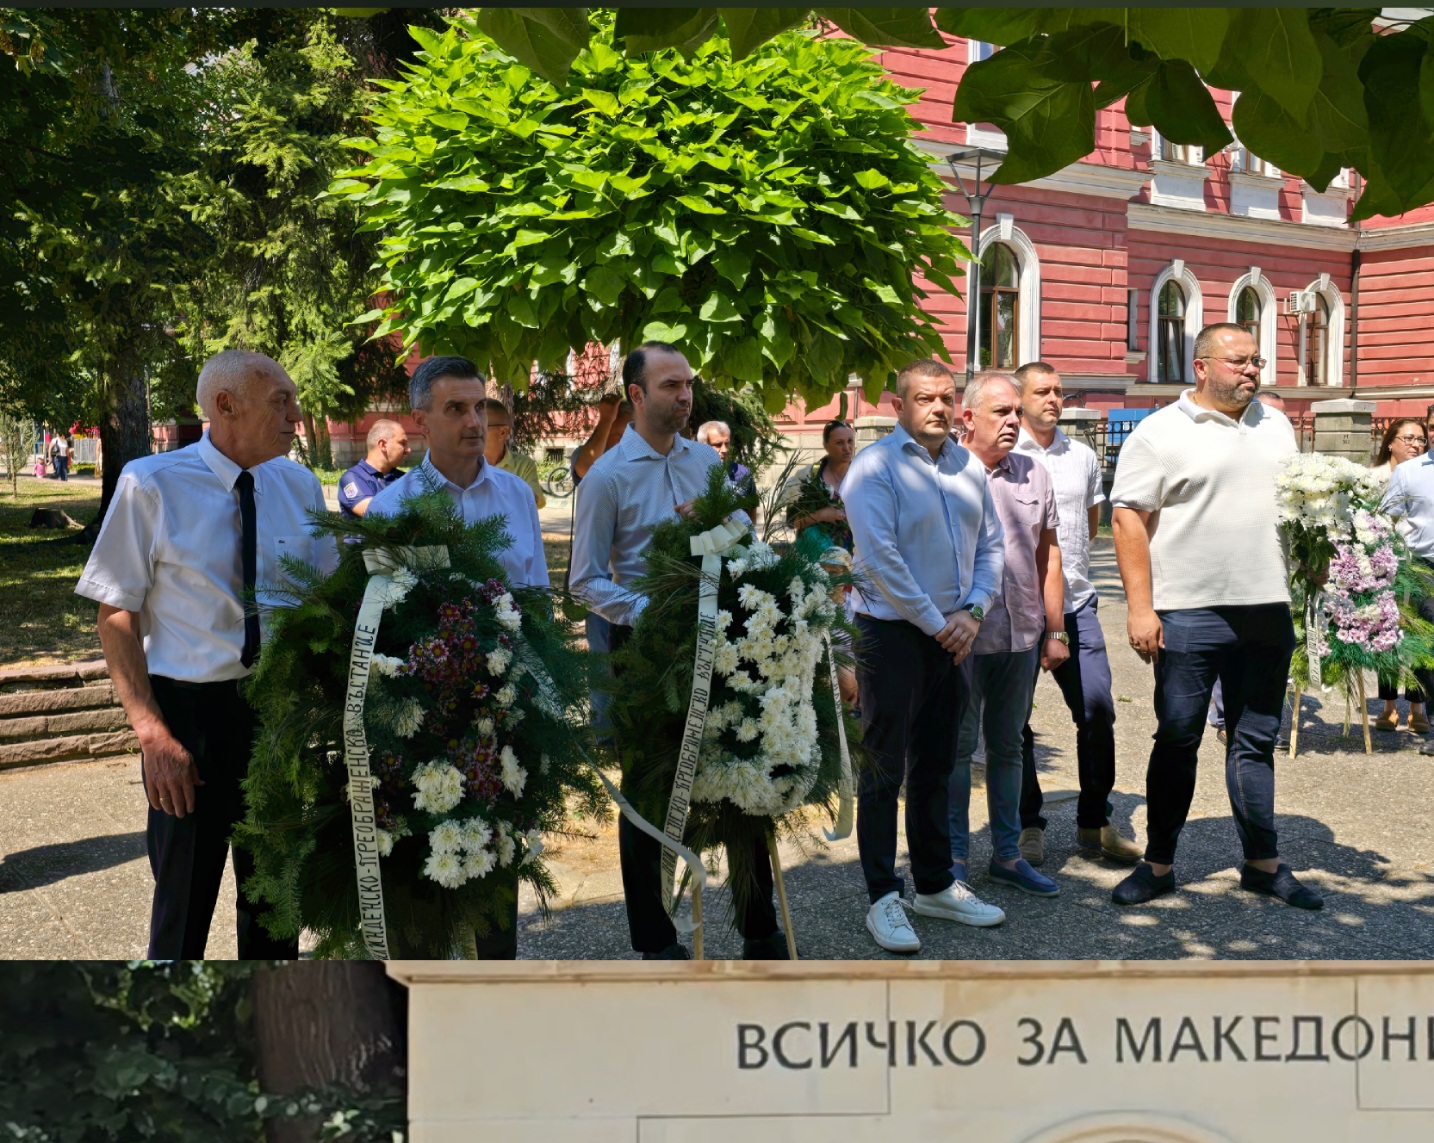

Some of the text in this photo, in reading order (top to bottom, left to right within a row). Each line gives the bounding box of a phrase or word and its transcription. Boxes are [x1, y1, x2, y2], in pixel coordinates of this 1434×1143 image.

[346, 624, 388, 959] ЛИНДЕНСКО-ПРЕОБРАЖЕНСКО ВЪСТАНИЕ
[736, 1020, 987, 1069] ВСИЧКО
[1016, 1017, 1088, 1066] ЗА
